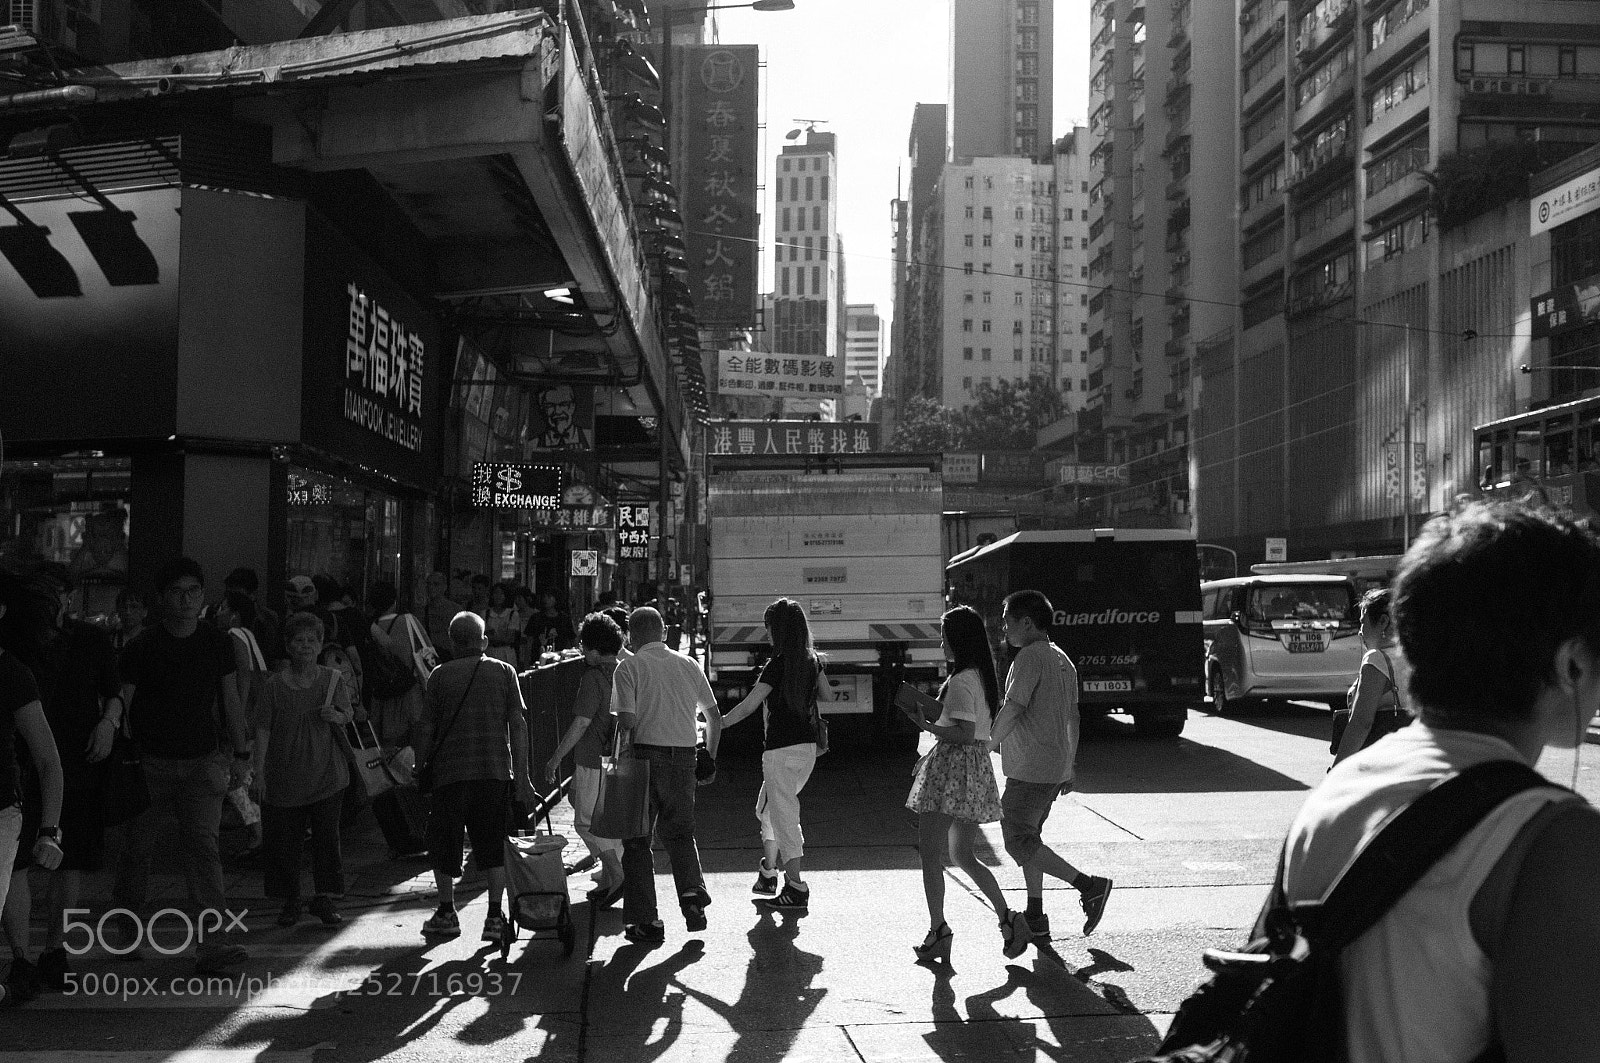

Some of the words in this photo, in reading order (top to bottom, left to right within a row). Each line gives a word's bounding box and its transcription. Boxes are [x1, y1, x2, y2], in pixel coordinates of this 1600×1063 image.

[703, 100, 737, 301] 春夏秋冬火鍋
[346, 281, 424, 418] 萬福珠寶
[727, 356, 835, 378] 全能數碼影像
[384, 411, 423, 452] JEWELLERY
[713, 427, 871, 454] 港豐人民幣找換
[494, 492, 557, 508] EXCHANGE
[1052, 608, 1160, 626] Guardforce
[1078, 655, 1106, 666] 2765
[1110, 654, 1138, 665] 7654
[1086, 682, 1100, 690] TY
[1103, 681, 1129, 690] 1803
